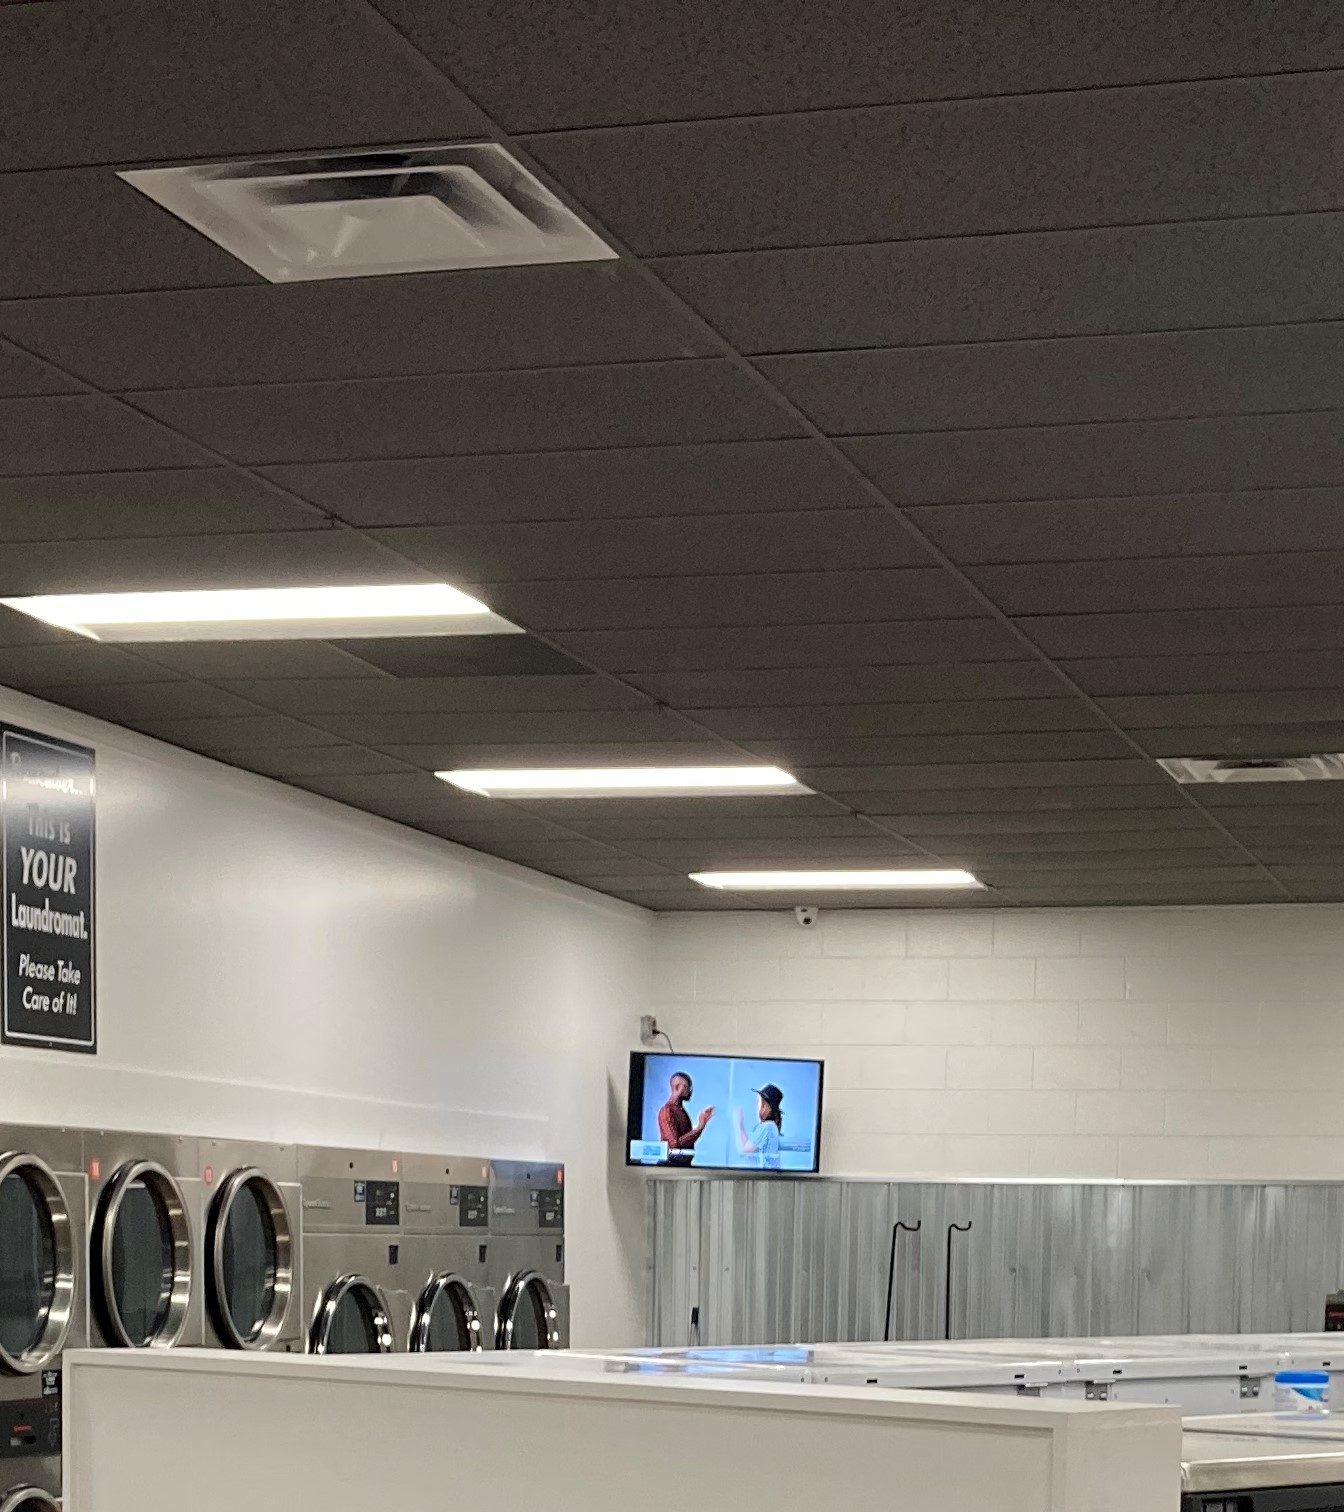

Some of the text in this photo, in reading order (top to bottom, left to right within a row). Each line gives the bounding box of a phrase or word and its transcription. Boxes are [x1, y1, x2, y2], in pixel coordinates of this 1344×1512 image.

[59, 815, 71, 845] is
[20, 845, 77, 895] YOUR
[11, 891, 88, 940] Laundromat.
[18, 952, 81, 986] Please Take
[22, 985, 78, 1016] Care of It!
